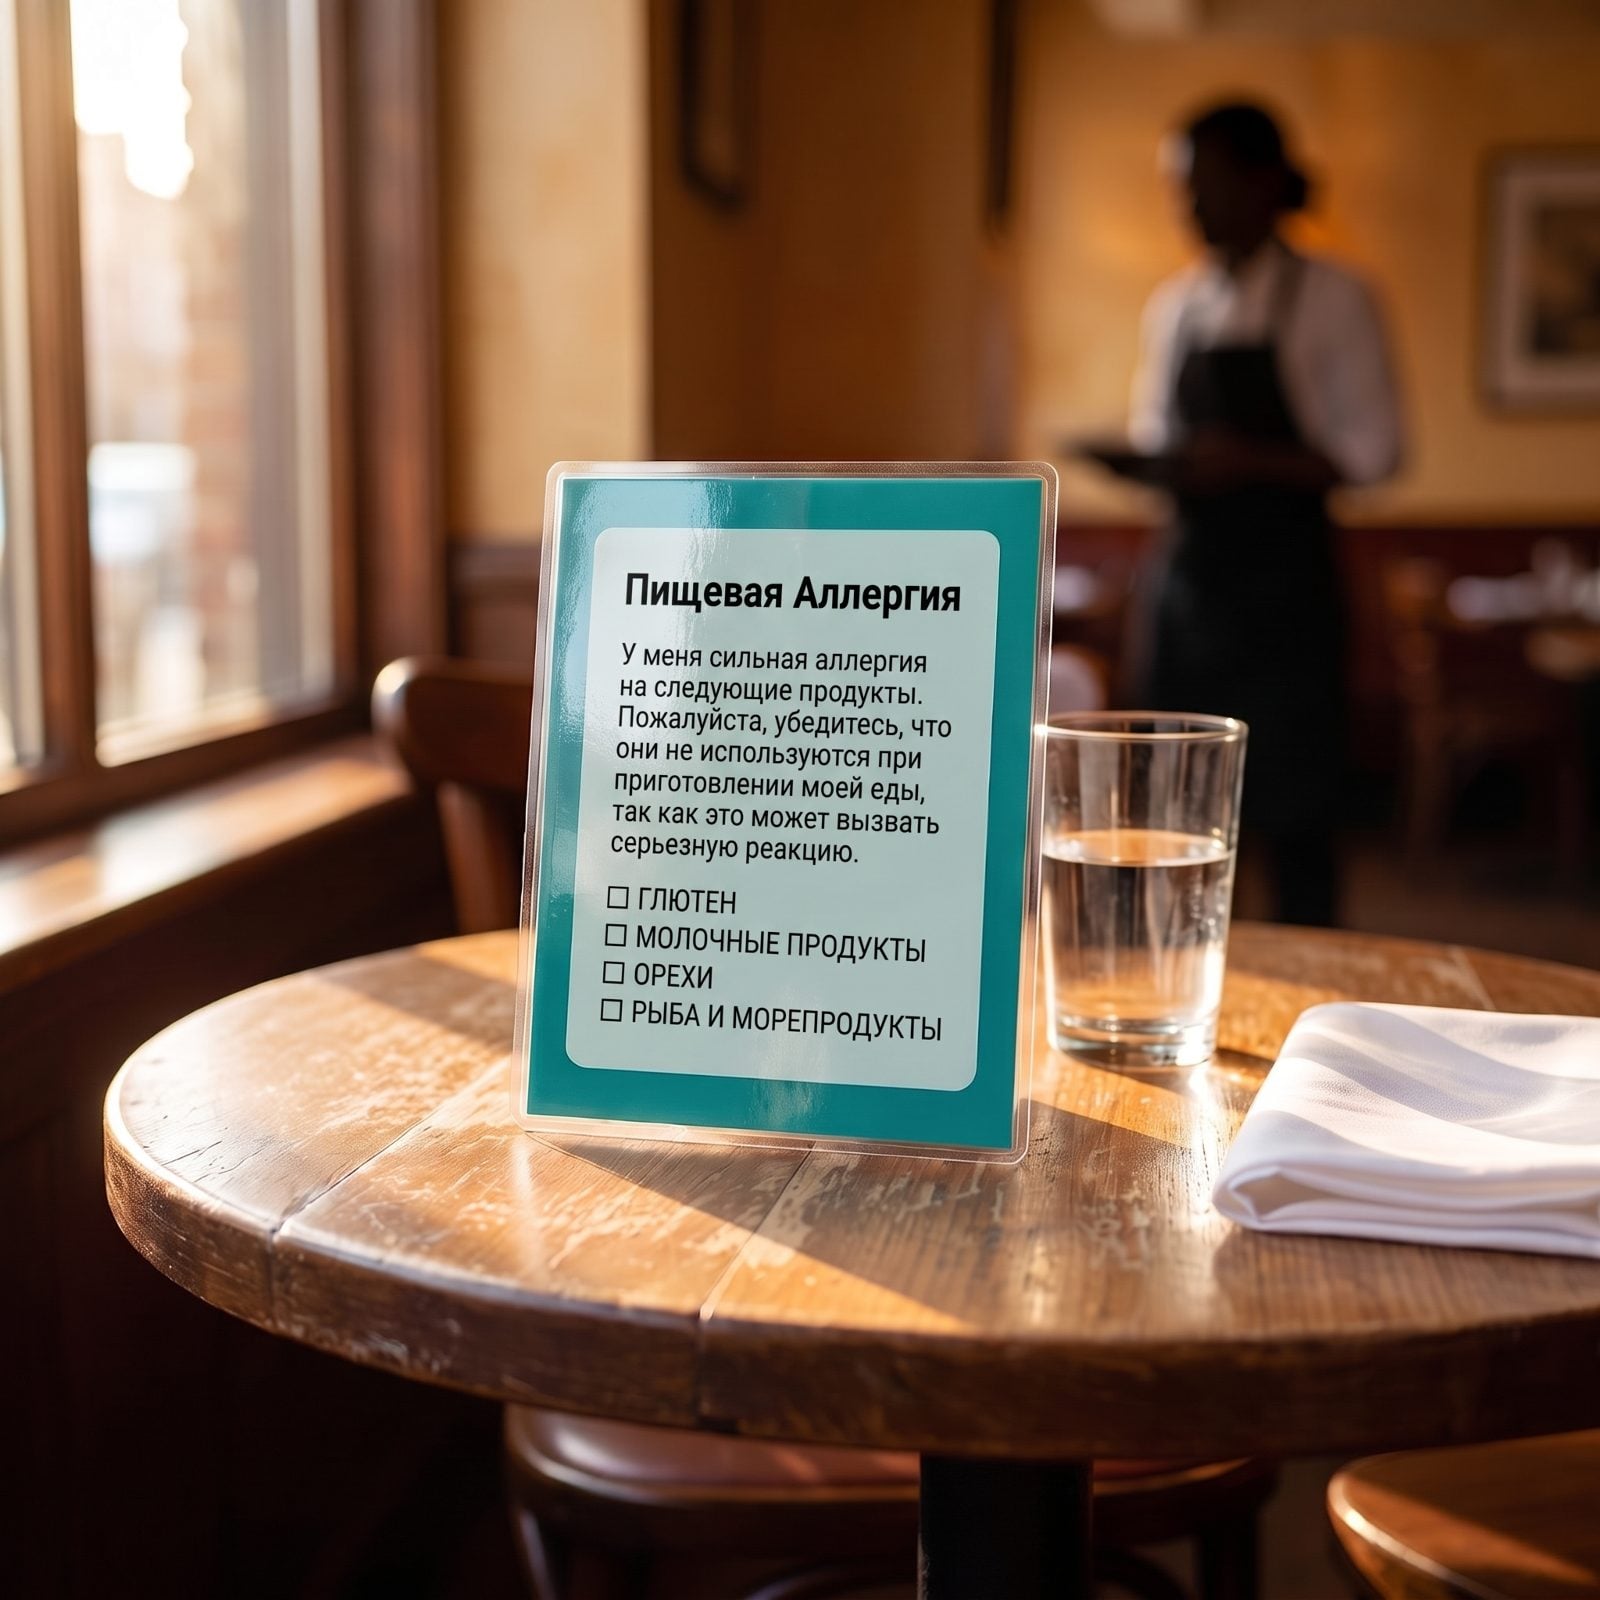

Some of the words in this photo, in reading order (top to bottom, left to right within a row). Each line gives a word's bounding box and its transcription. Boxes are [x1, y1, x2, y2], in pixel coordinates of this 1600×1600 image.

[625, 572, 783, 614] Пищевая
[792, 575, 961, 620] Аллергия
[622, 642, 637, 666] У
[643, 648, 702, 667] меня
[709, 650, 808, 670] сильная
[815, 652, 927, 678] аллергия
[620, 679, 647, 697] на
[654, 680, 793, 705] следующие
[799, 683, 923, 710] продукты.
[618, 705, 767, 736] Пожалуйста,
[774, 708, 904, 740] убедитесь,
[911, 718, 952, 738] что
[616, 741, 658, 760] они
[666, 743, 693, 761] не
[700, 743, 870, 772] используются
[878, 750, 922, 775] при
[614, 772, 794, 797] приготовлении
[801, 775, 863, 800] моей
[870, 781, 925, 806] еды,
[612, 804, 652, 823] так
[658, 805, 699, 825] как
[705, 807, 744, 827] это
[751, 809, 830, 830] может
[836, 812, 940, 835] вызвать
[611, 835, 739, 863] серьезную
[745, 840, 859, 866] реакцию.
[638, 886, 737, 915] ГЛЮТЕН
[636, 924, 781, 955] МОЛОЧНЫЕ
[787, 932, 926, 965] ПРОДУКТЫ
[634, 962, 713, 990] ОРЕХИ
[632, 999, 701, 1027] РЫБА
[708, 1004, 724, 1028] И
[732, 1005, 942, 1043] МОРЕПРОДУКТЫ
